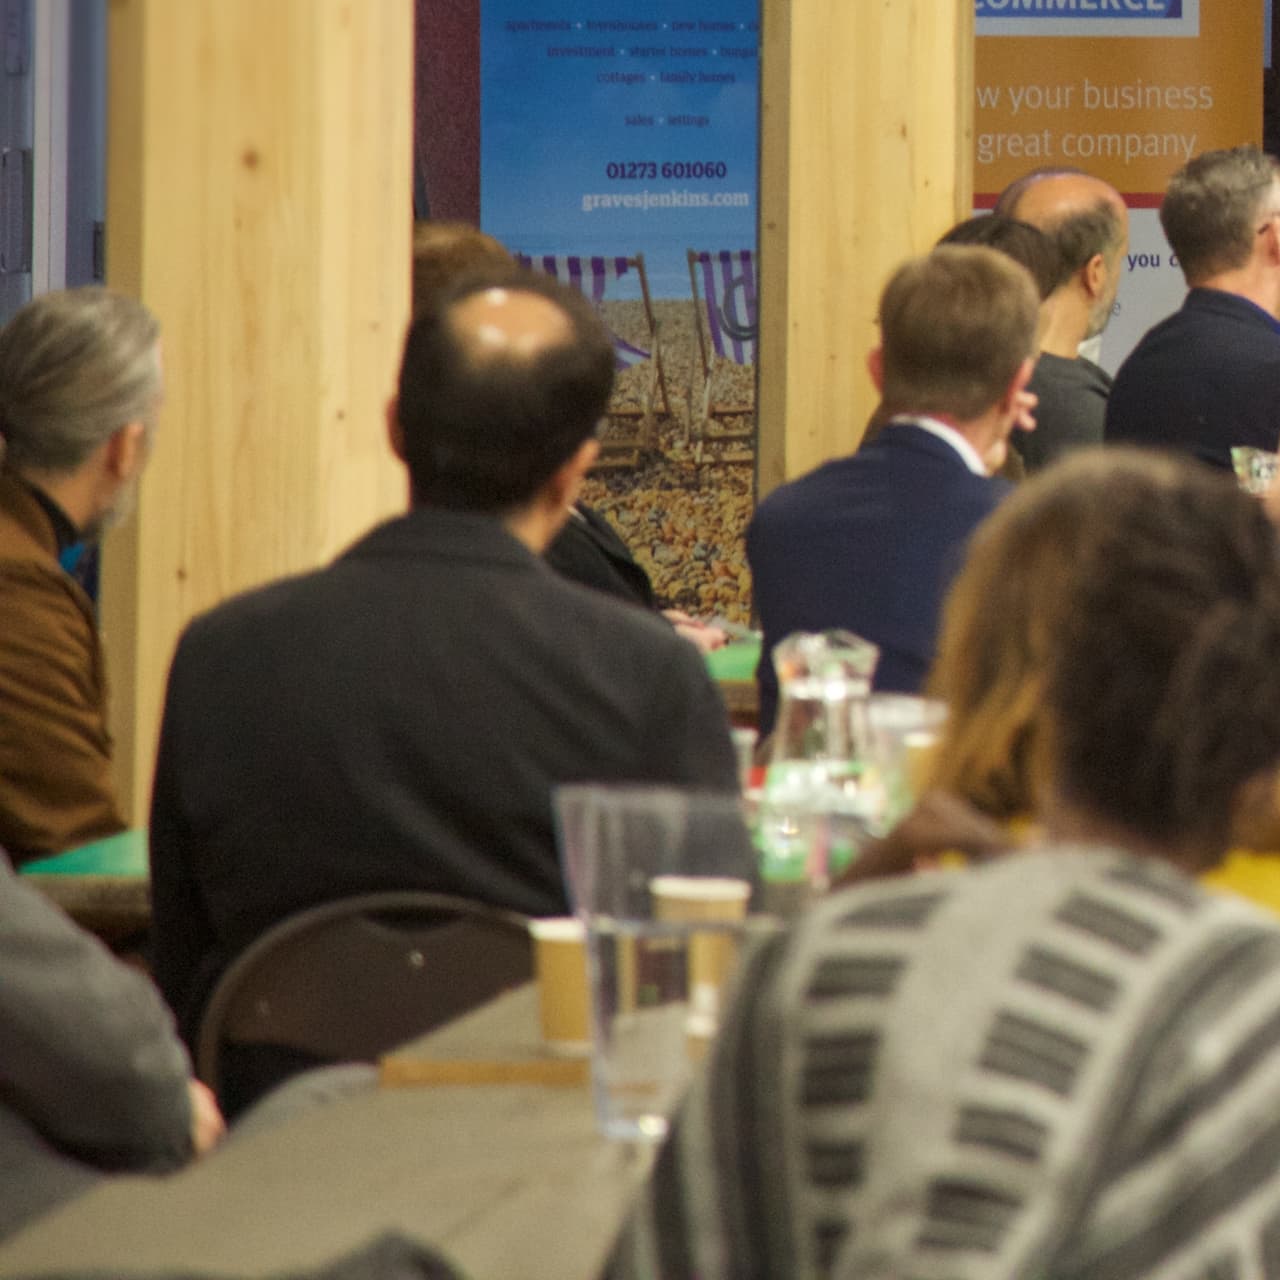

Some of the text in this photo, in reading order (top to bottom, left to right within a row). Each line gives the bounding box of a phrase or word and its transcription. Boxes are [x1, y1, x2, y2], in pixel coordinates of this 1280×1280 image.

[1008, 84, 1075, 114] your
[1083, 78, 1214, 110] business
[976, 128, 1198, 164] great company
[606, 161, 728, 179] 01273 601060
[581, 189, 750, 212] gravesjenkins.com
[1127, 252, 1160, 272] you
